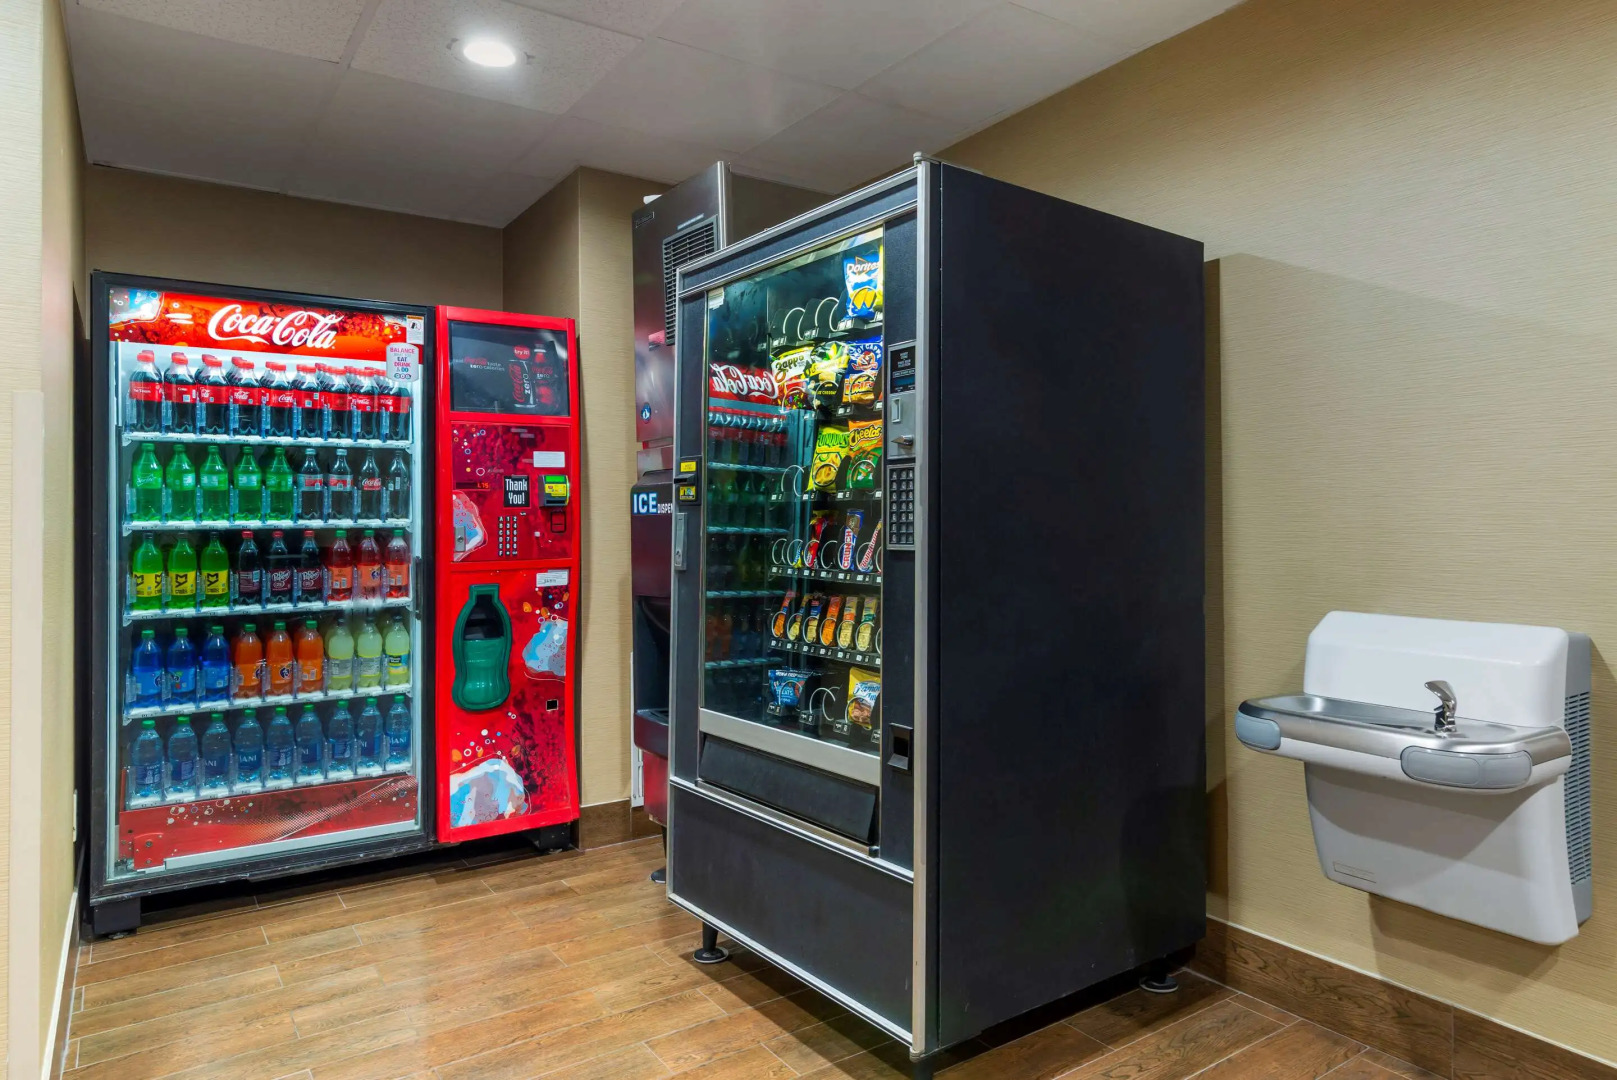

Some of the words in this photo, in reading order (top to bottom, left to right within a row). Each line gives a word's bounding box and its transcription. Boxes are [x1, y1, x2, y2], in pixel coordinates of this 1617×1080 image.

[847, 262, 879, 273] Doritos
[208, 304, 345, 350] Coca-Cola
[523, 374, 531, 394] zero
[849, 424, 883, 449] Cheetos
[505, 479, 528, 491] Thank
[508, 492, 525, 505] You!
[633, 493, 658, 514] ICE
[842, 529, 853, 569] CRUNCH
